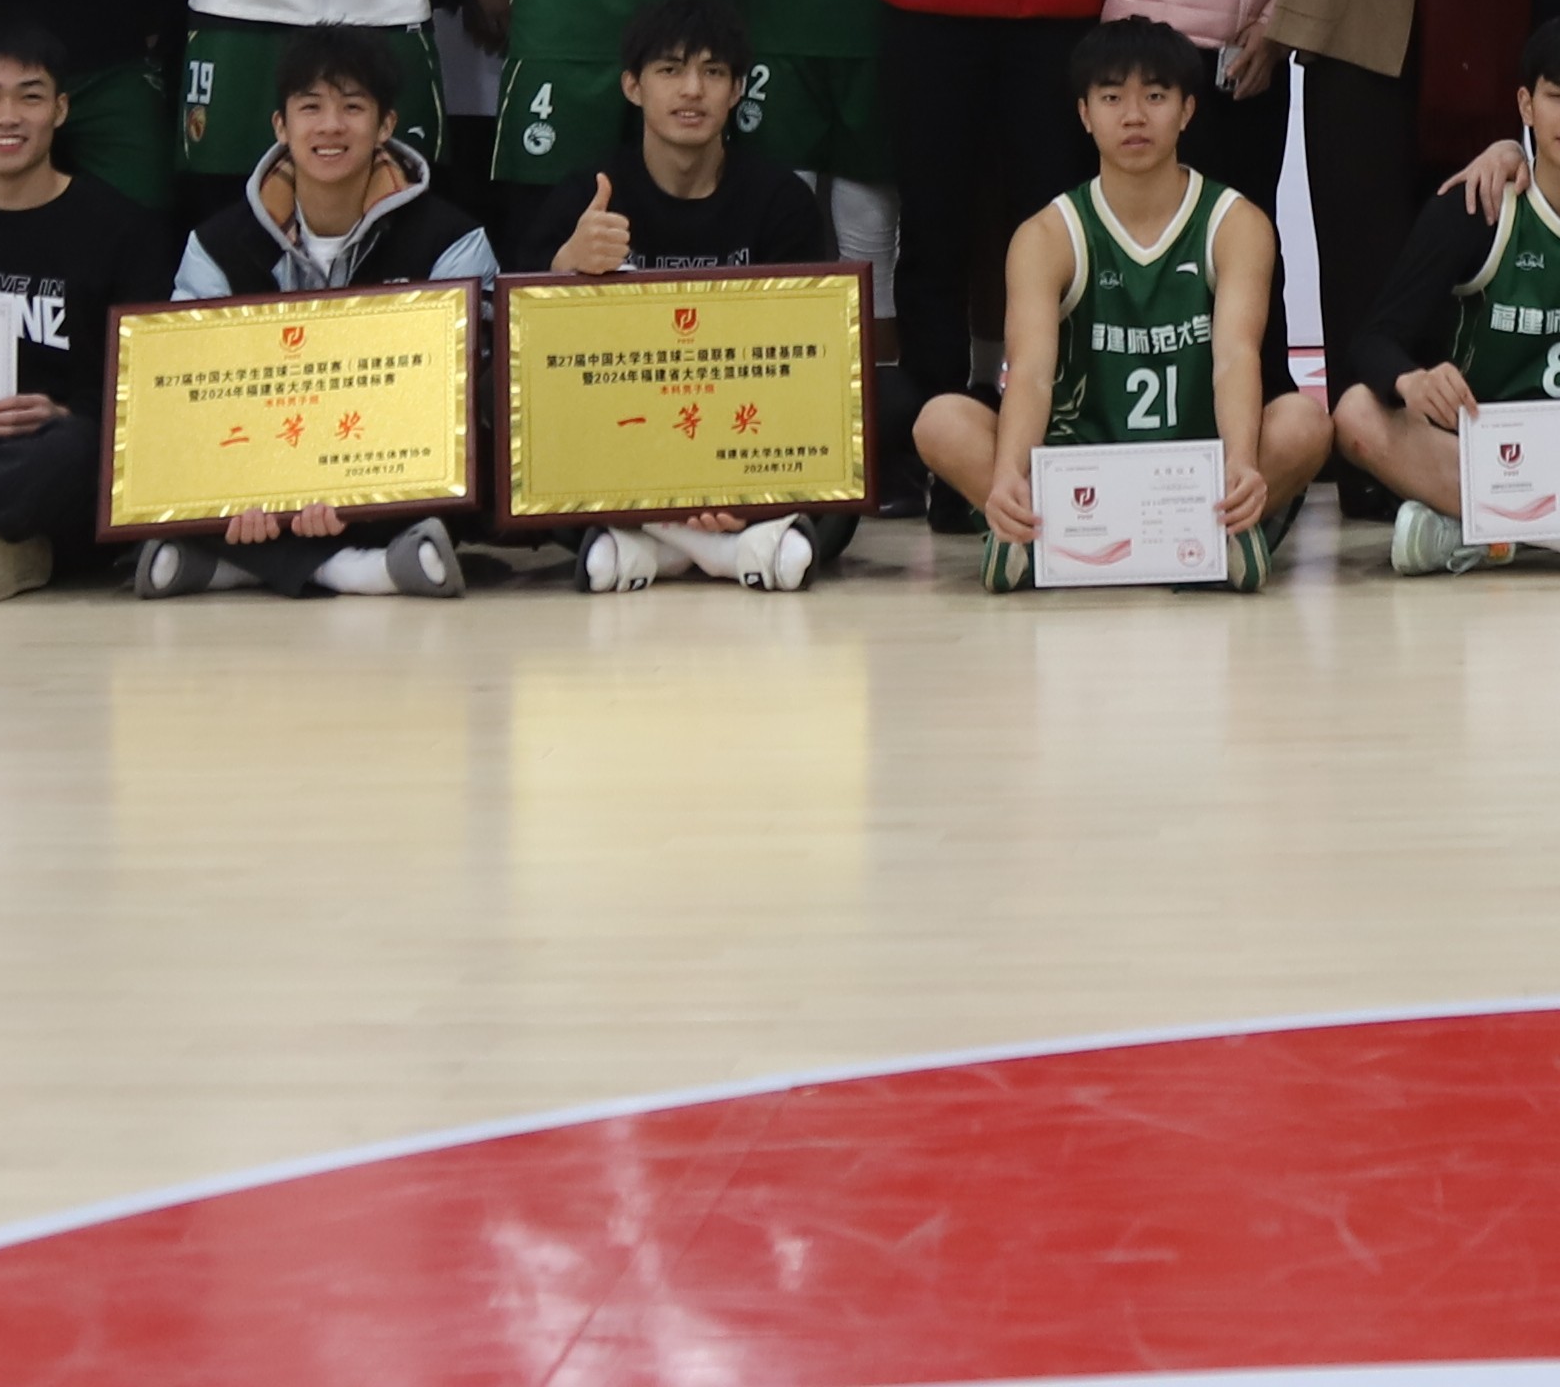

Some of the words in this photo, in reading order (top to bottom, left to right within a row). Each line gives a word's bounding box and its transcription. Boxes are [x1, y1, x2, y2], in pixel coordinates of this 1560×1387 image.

[187, 60, 214, 104] 19
[530, 83, 553, 120] 4
[1126, 365, 1178, 430] 21
[219, 410, 365, 449] 二等奖
[616, 402, 762, 440] 一等奖
